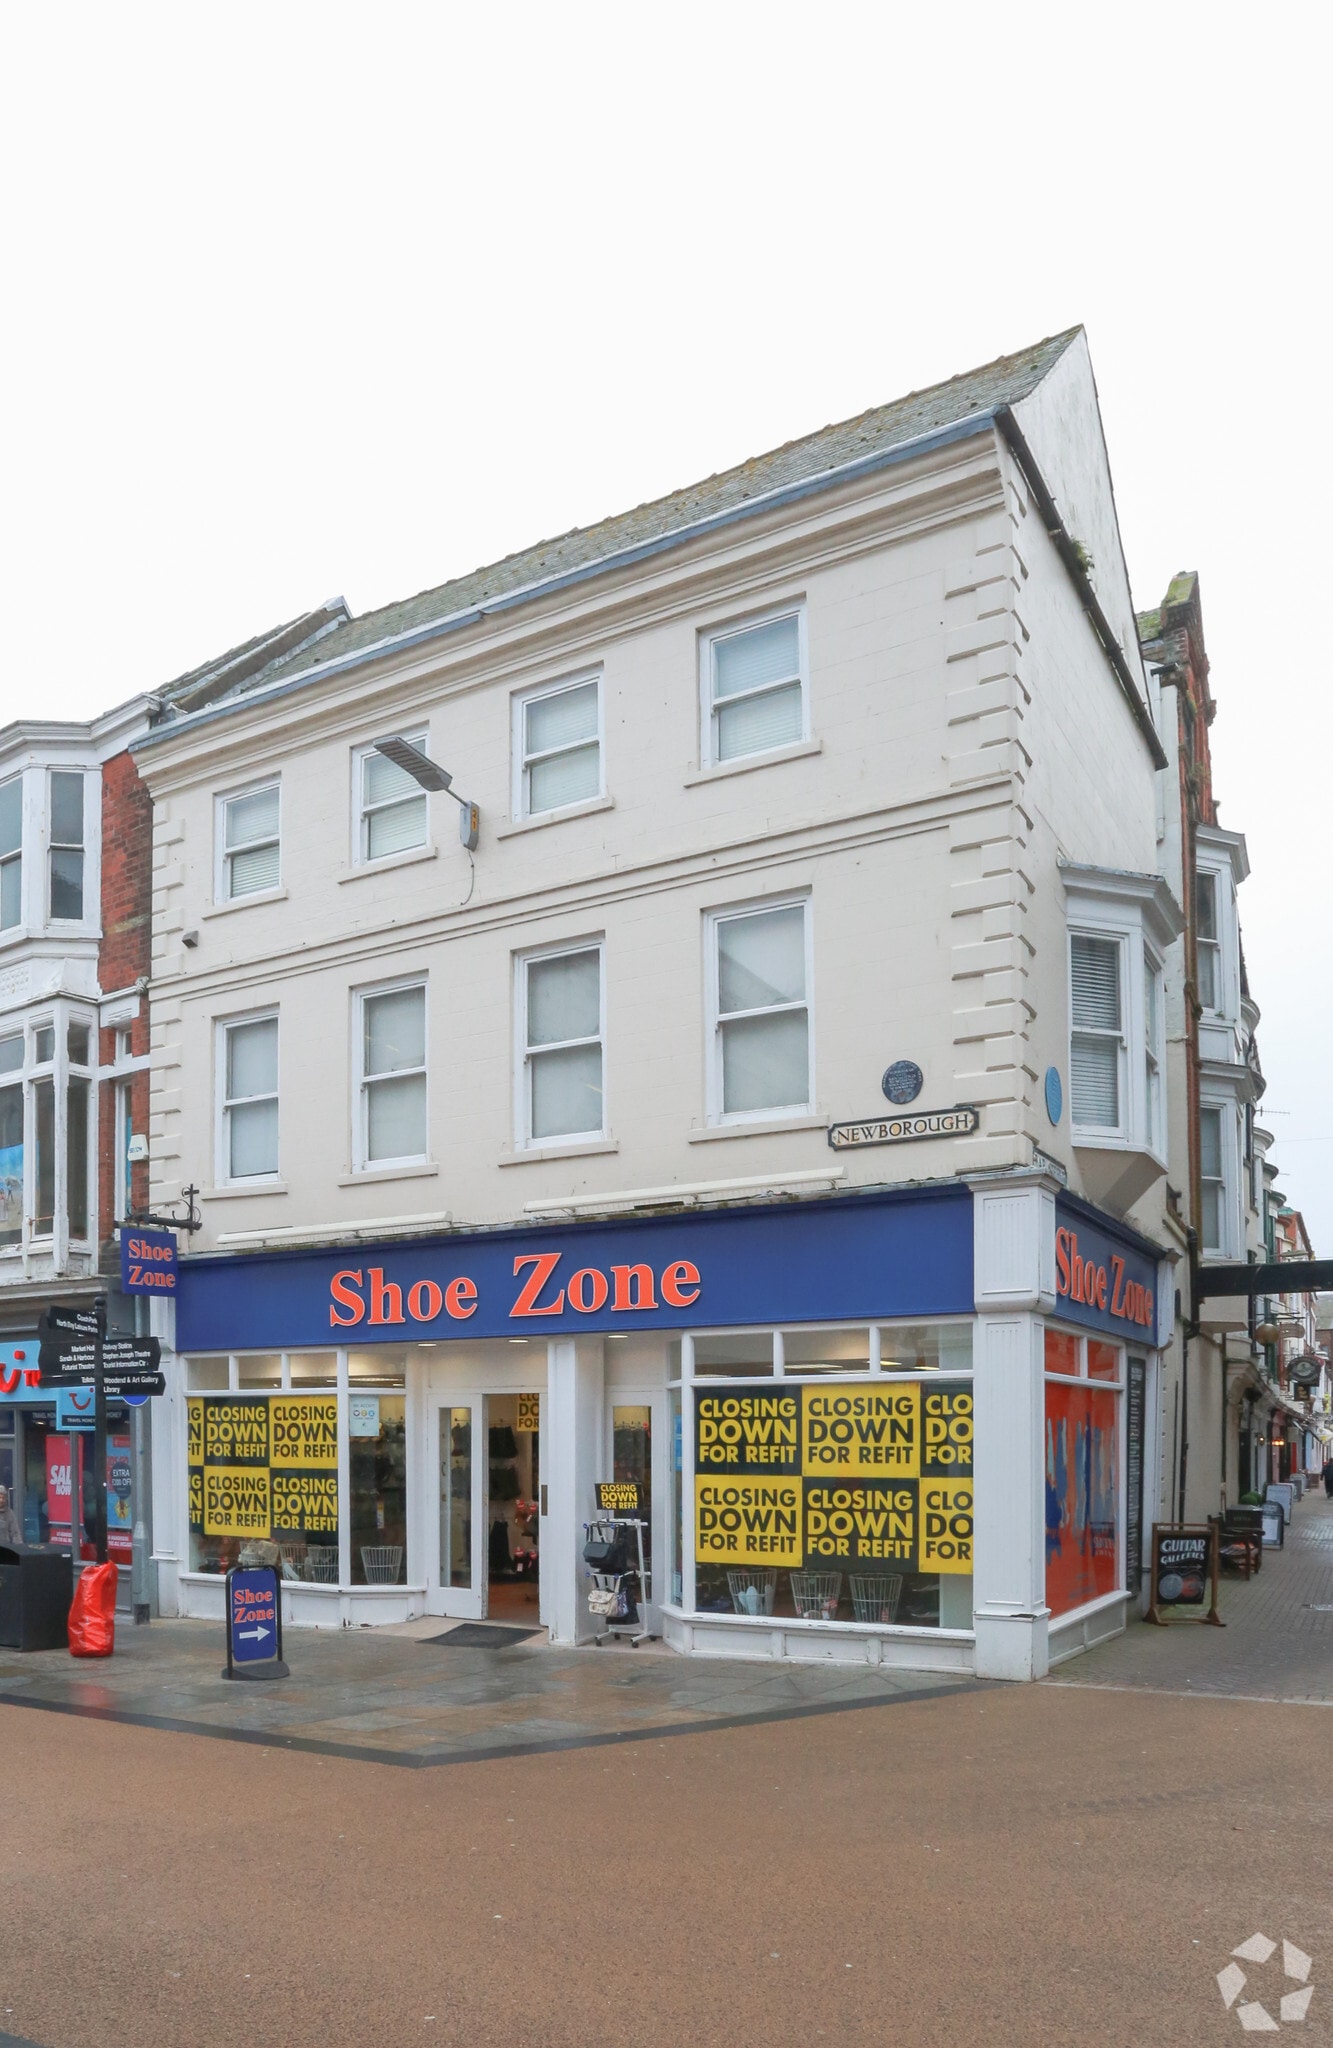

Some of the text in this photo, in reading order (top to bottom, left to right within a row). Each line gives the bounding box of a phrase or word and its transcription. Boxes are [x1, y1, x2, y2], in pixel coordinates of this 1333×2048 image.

[837, 1114, 969, 1144] NEWBOROUGH
[128, 1239, 173, 1261] Shoe
[128, 1265, 176, 1288] Zone
[1056, 1227, 1154, 1328] Shoe Zone
[330, 1252, 701, 1327] Shoe Zone
[104, 1386, 120, 1394] Library
[207, 1406, 266, 1421] CLOSING
[274, 1406, 336, 1421] CLOSING
[699, 1397, 796, 1417] CLOSING
[808, 1396, 914, 1417] CLOSING
[207, 1423, 267, 1442] DOWN
[274, 1423, 337, 1442] DOWN
[518, 1418, 539, 1428] FOR
[699, 1419, 797, 1444] DOWN
[808, 1418, 914, 1444] DOWN
[207, 1443, 267, 1457] FOR REFIT
[274, 1444, 337, 1458] FOR REFIT
[699, 1445, 797, 1463] FOR REFIT
[808, 1446, 914, 1464] FOR REFIT
[925, 1445, 972, 1464] FOR
[113, 1469, 130, 1477] EXTRA
[208, 1476, 266, 1491] CLOSING
[273, 1477, 337, 1494] CLOSING
[601, 1484, 637, 1492] CLOSING
[208, 1492, 267, 1512] DOWN
[273, 1494, 337, 1515] DOWN
[601, 1492, 637, 1501] DOWN
[700, 1487, 796, 1507] CLOSING
[807, 1489, 913, 1511] CLOSING
[208, 1512, 267, 1527] FOR REFIT
[274, 1515, 337, 1531] FOR REFIT
[700, 1508, 797, 1533] DOWN
[807, 1510, 913, 1538] DOWN
[699, 1533, 796, 1553] FOR REFIT
[807, 1537, 913, 1559] FOR REFIT
[925, 1541, 971, 1560] FOR
[1161, 1539, 1205, 1552] GUITAR
[1160, 1552, 1204, 1564] GALLERIES
[234, 1589, 272, 1604] Shoe
[234, 1607, 274, 1624] Zone
